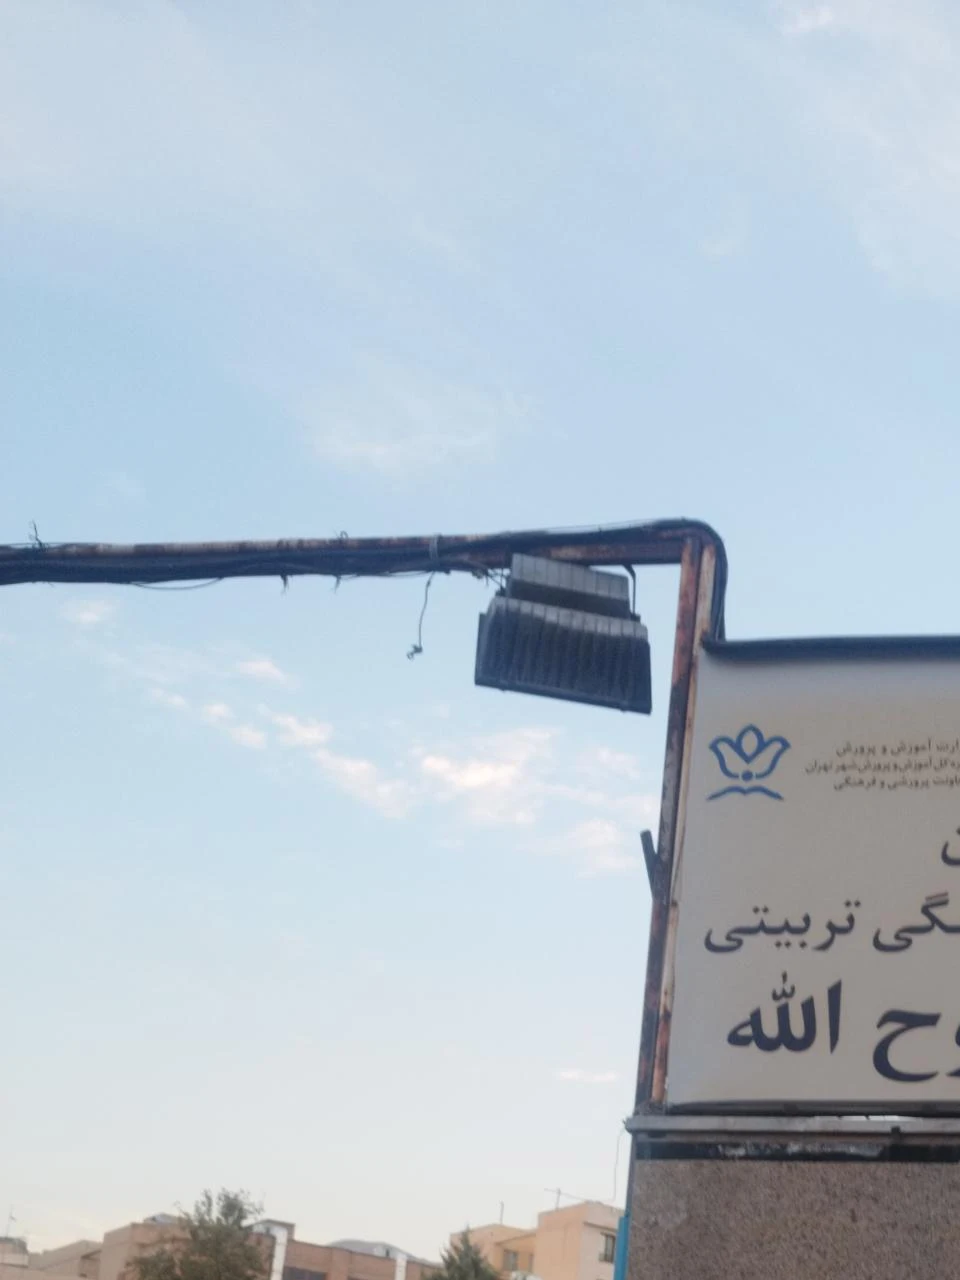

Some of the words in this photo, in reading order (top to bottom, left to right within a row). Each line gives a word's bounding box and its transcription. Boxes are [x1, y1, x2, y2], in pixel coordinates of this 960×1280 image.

[835, 741, 876, 758] پرورش
[881, 745, 887, 756] و
[890, 736, 931, 757] آموزش
[899, 756, 932, 773] آموزش
[703, 898, 862, 953] تربیتی
[726, 969, 842, 1056] الله
